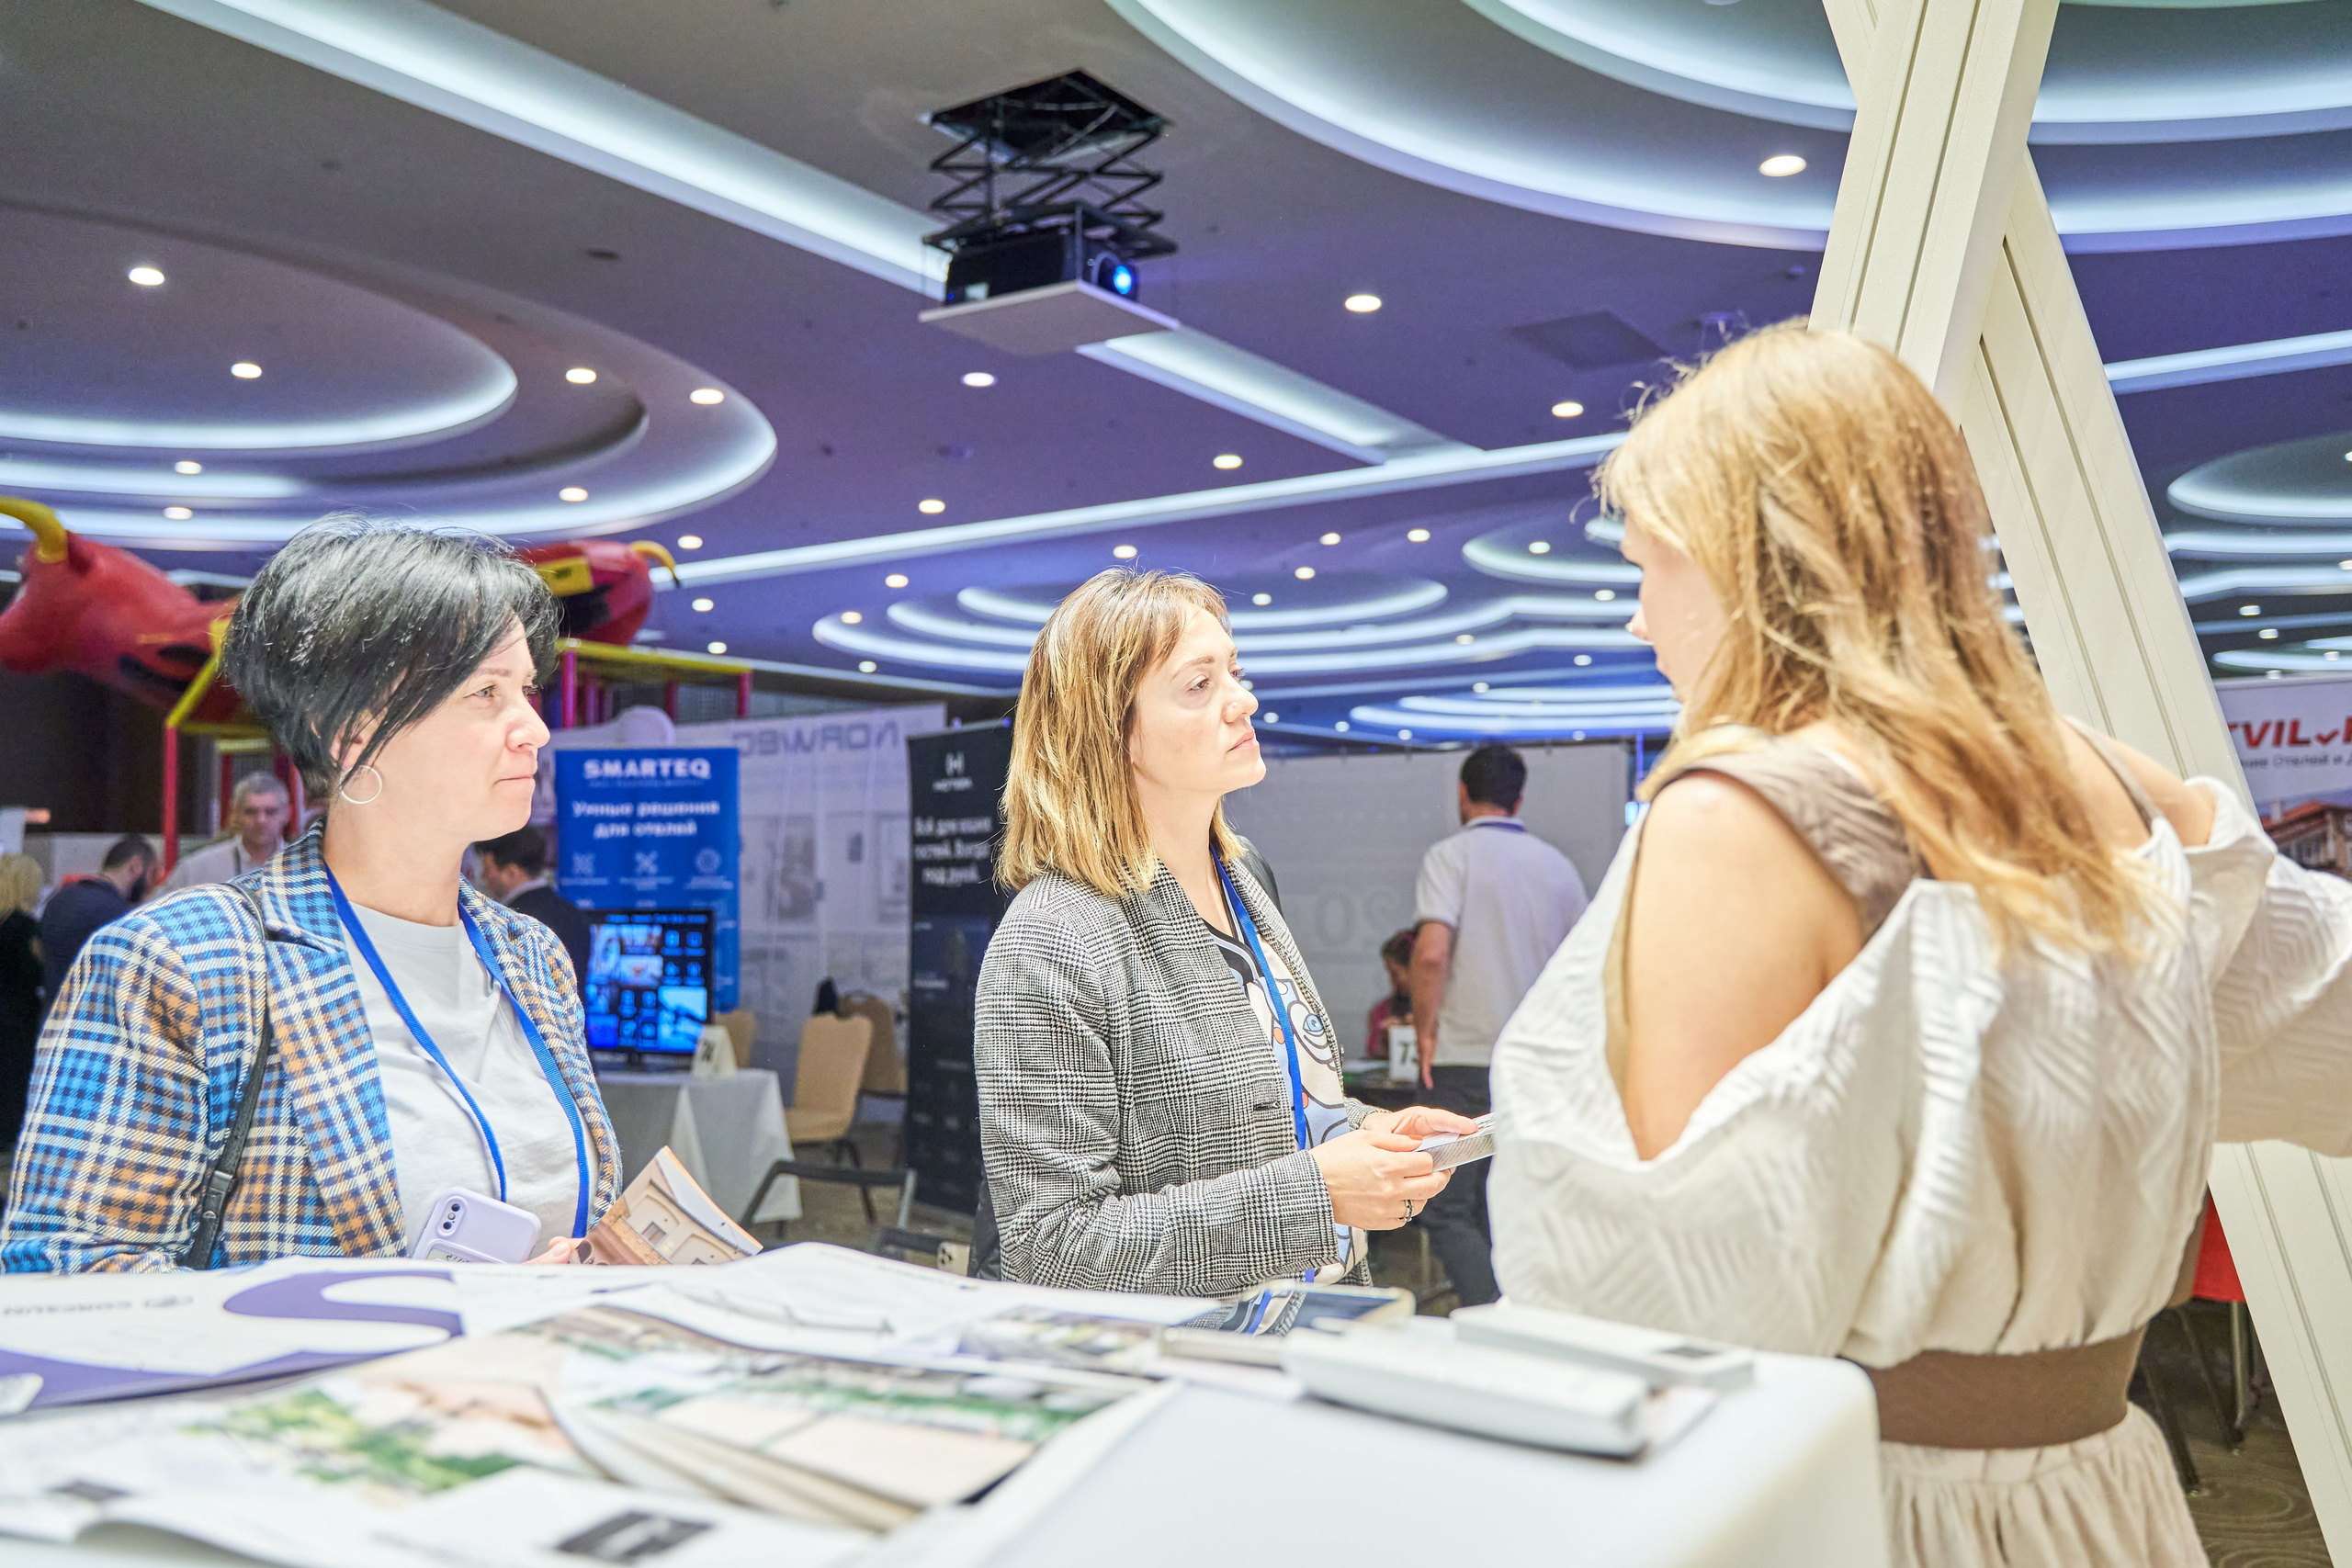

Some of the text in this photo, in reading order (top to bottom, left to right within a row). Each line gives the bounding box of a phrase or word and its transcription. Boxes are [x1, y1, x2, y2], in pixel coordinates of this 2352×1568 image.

[583, 758, 711, 780] SMARTEQ
[572, 801, 720, 817] Умные решения
[594, 818, 697, 839] для отелей
